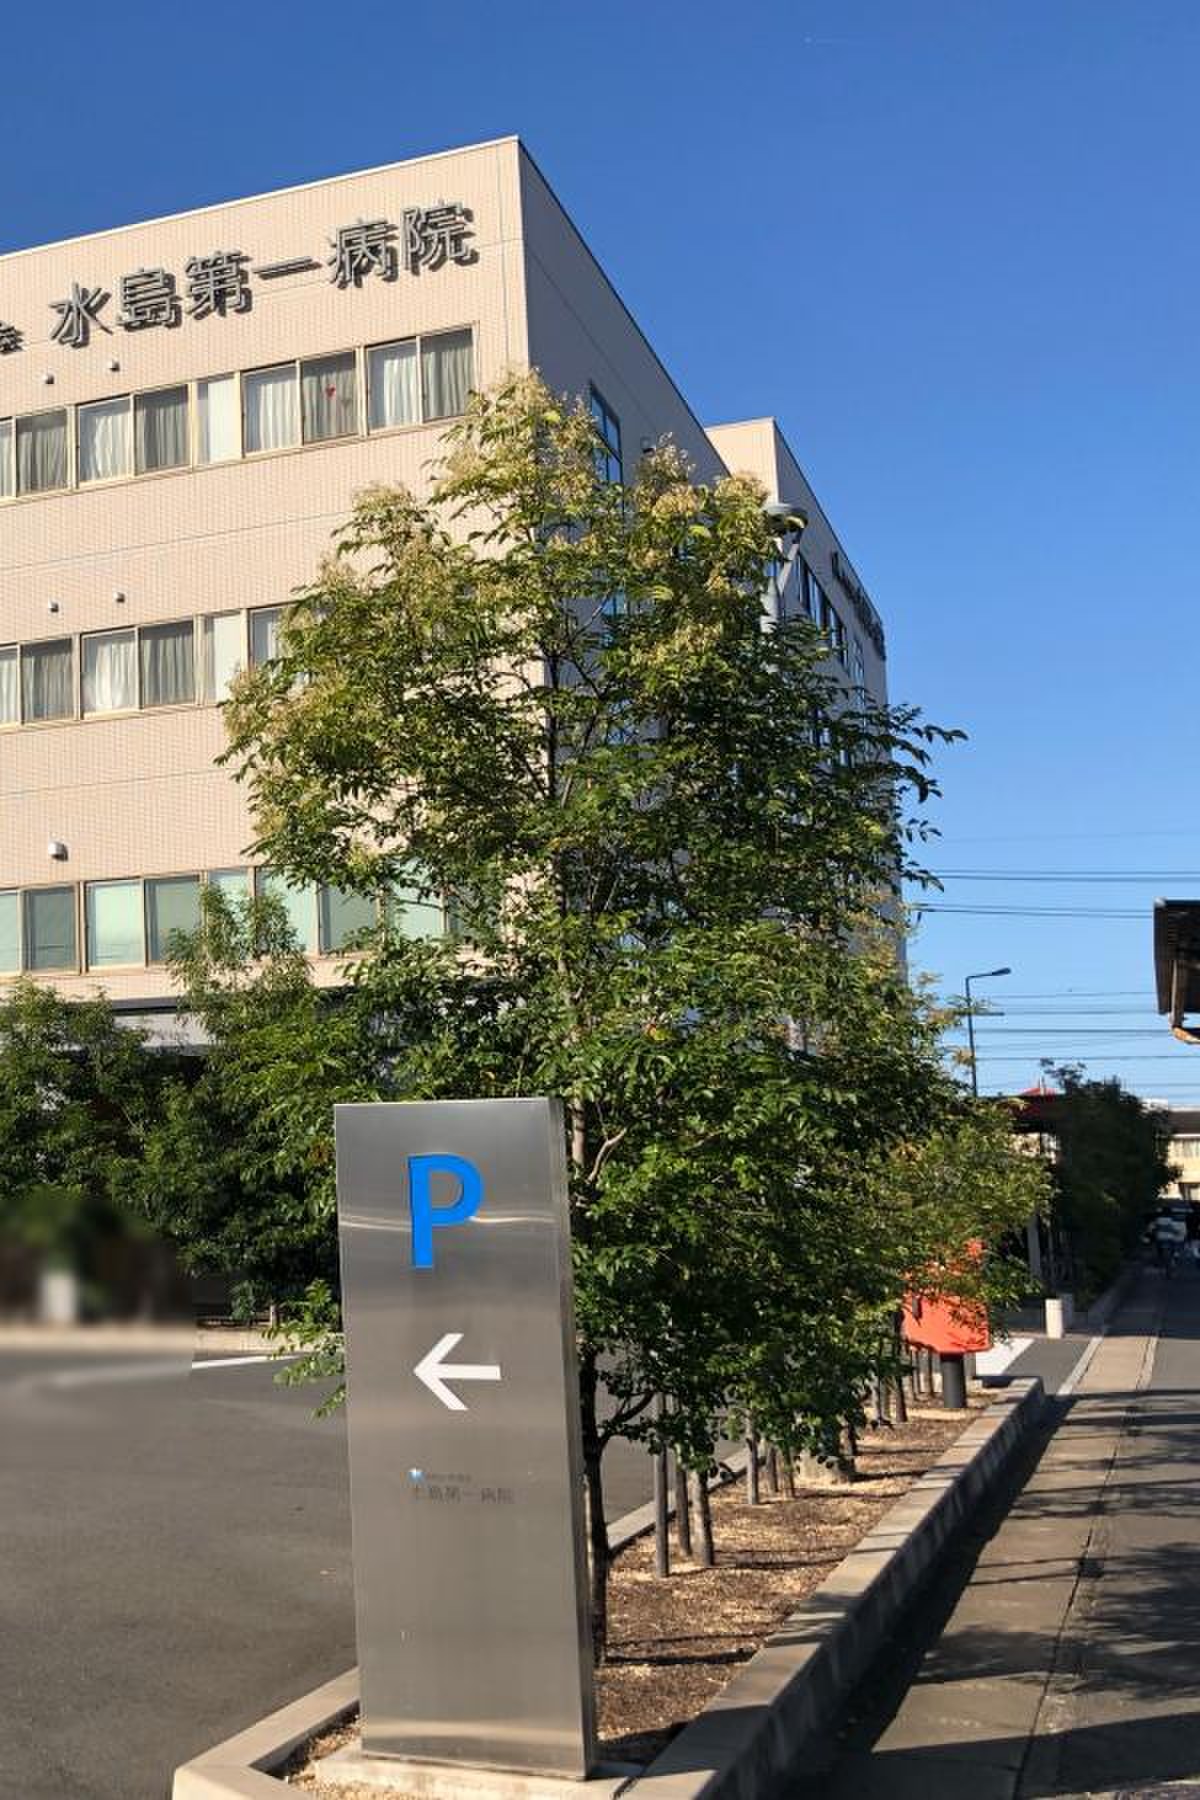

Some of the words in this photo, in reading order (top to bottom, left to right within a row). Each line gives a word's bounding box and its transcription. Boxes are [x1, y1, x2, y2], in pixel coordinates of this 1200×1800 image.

[50, 200, 479, 347] 水島第一病院
[408, 1154, 484, 1268] P
